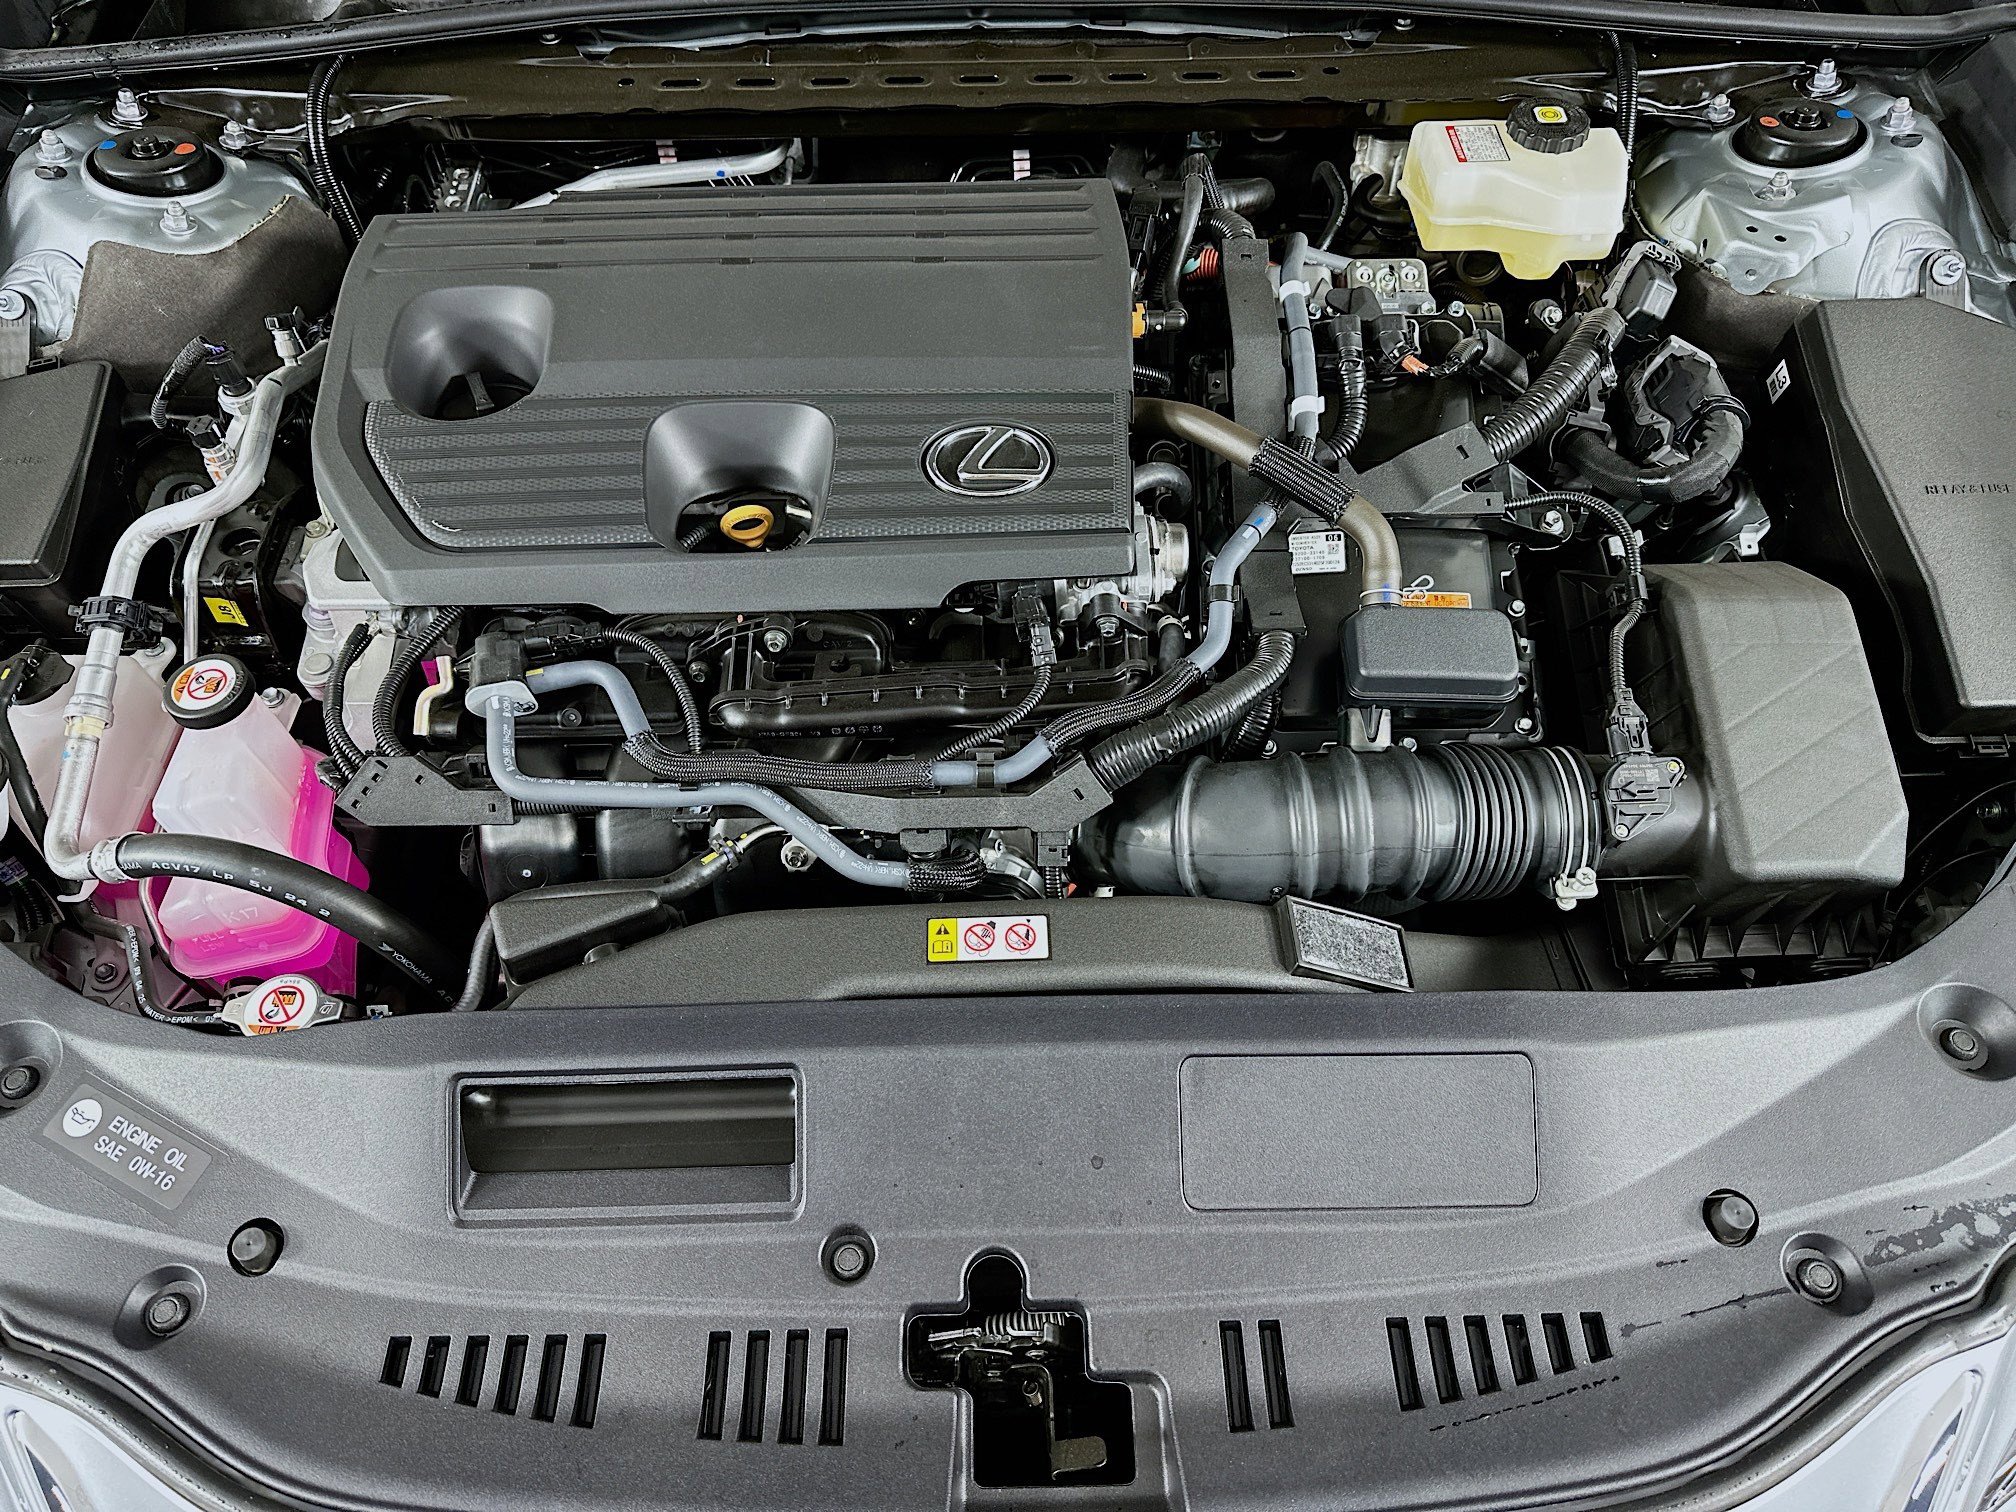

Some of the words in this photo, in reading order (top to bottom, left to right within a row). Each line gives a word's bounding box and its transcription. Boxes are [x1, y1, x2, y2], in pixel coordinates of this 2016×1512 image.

[1775, 365, 1787, 390] L3
[218, 605, 235, 619] J8
[151, 861, 201, 873] ACV17
[212, 869, 234, 880] LP
[284, 892, 308, 907] 24
[318, 908, 331, 918] 2
[391, 950, 433, 984] YOKOHAMA
[138, 993, 147, 1004] 25
[144, 1004, 165, 1021] WATER
[107, 1115, 162, 1154] ENGINE
[163, 1147, 188, 1172] OIL
[94, 1135, 127, 1162] SAE
[128, 1155, 176, 1191] 0W-16
